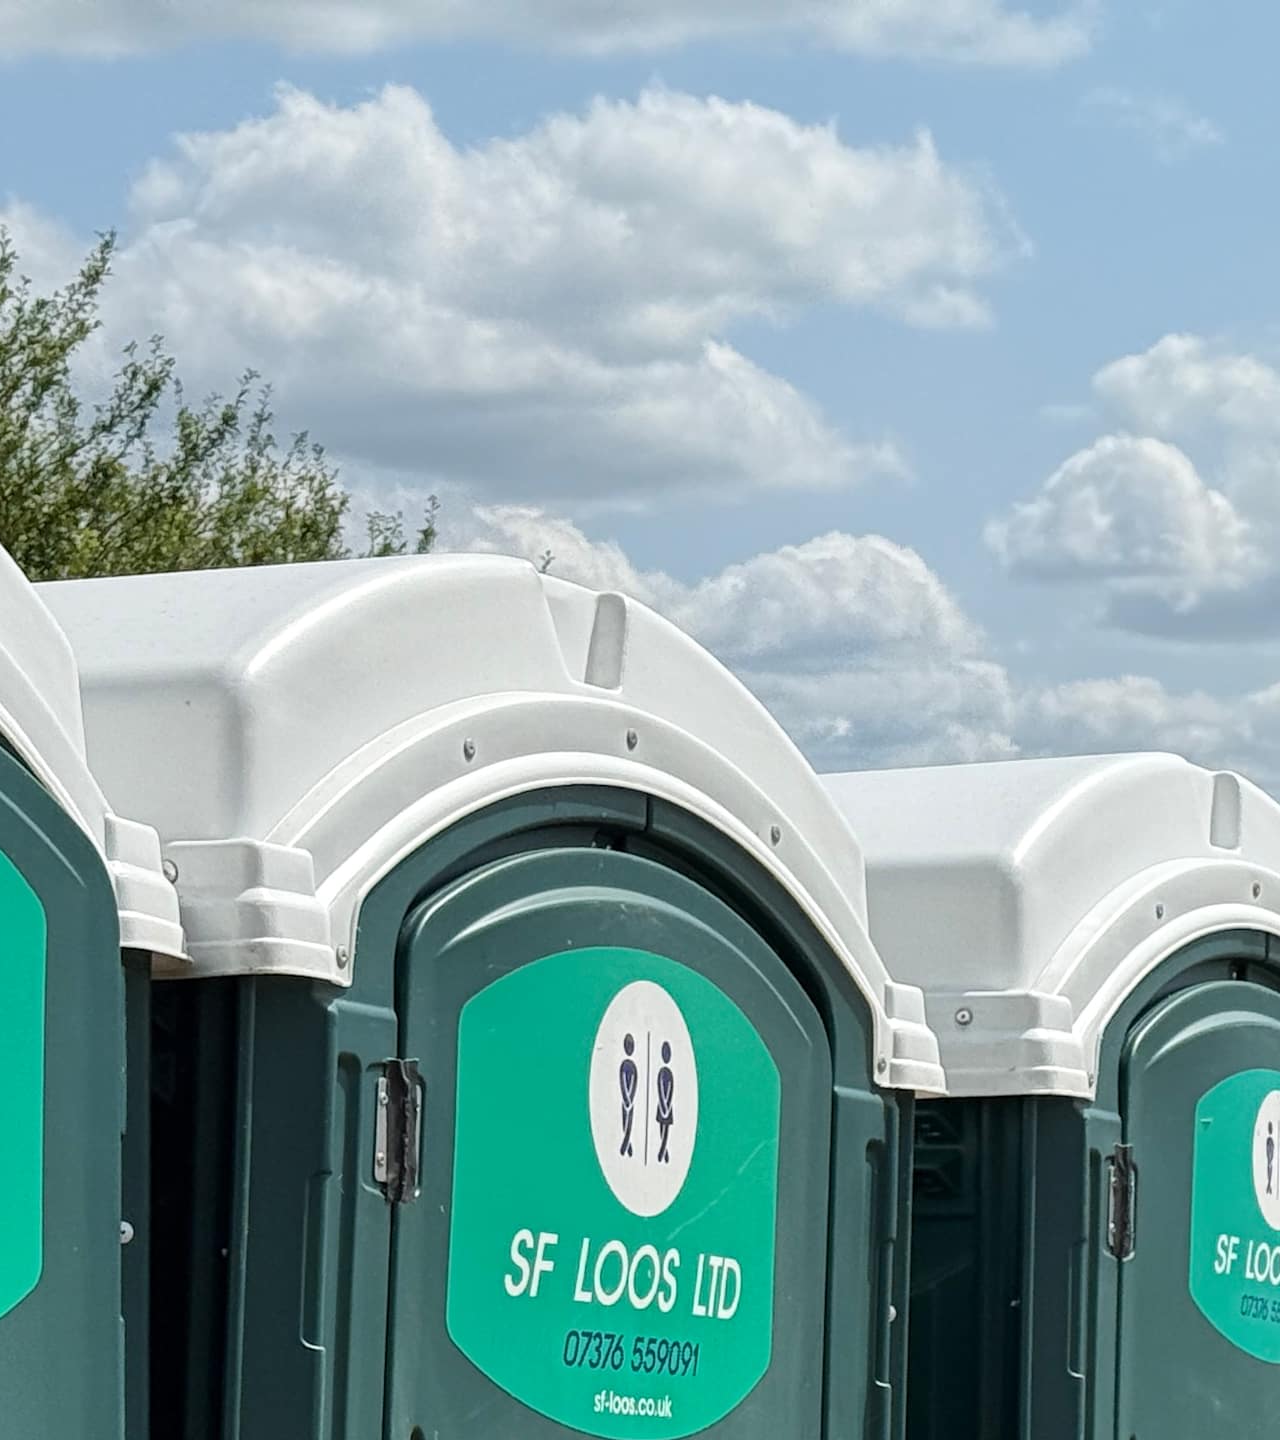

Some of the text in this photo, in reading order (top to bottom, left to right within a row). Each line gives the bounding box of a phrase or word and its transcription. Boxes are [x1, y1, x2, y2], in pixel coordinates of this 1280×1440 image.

[504, 1229, 742, 1320] SF LOOS LTD
[1214, 1234, 1240, 1274] SF
[563, 1330, 700, 1377] 07376 559091
[594, 1390, 672, 1418] sf-loos.co.uk
